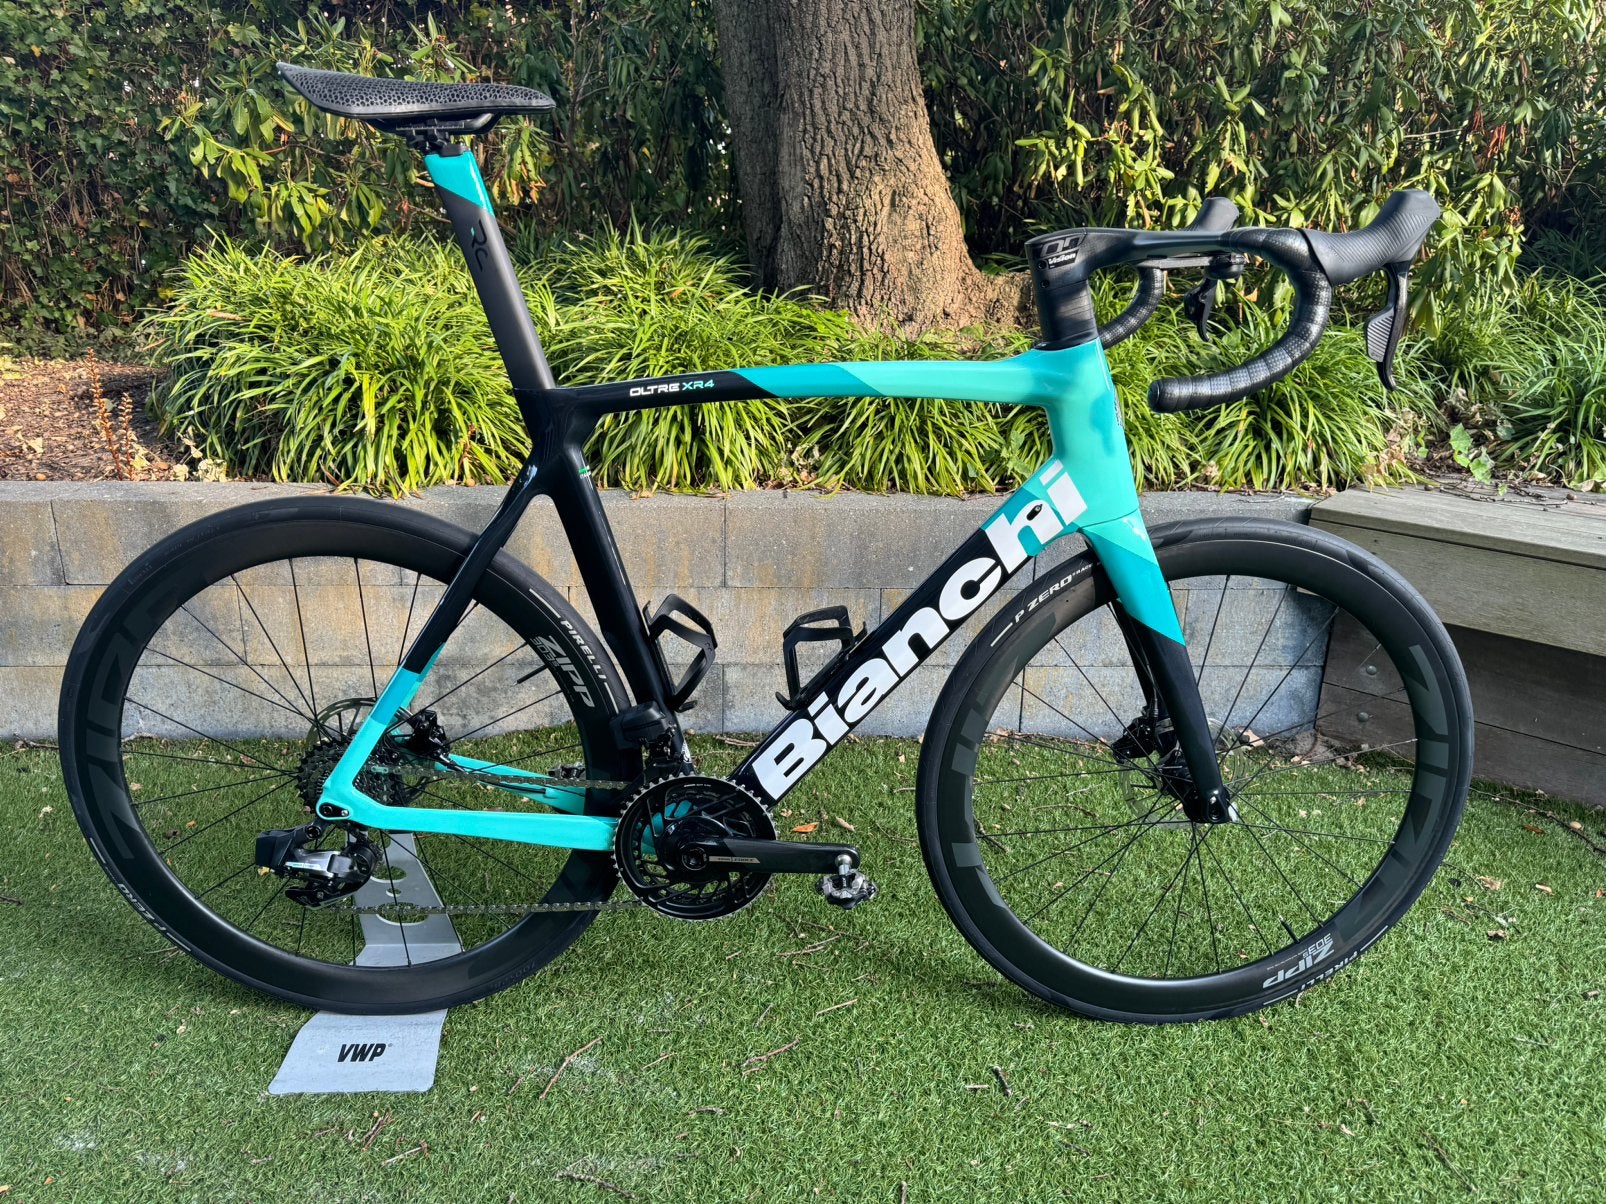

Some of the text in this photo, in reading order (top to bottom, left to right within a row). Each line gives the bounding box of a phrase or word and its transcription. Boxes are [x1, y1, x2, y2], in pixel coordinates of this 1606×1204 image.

[1048, 252, 1077, 265] Vision
[629, 379, 715, 397] OLTRE XR4
[1014, 609, 1025, 624] P
[1027, 574, 1073, 612] ZERO
[560, 620, 607, 680] PIRELLI
[752, 460, 1088, 801] Bianchi
[535, 634, 596, 708] ZIPP
[1262, 941, 1335, 989] ZIPP
[337, 1043, 387, 1063] VWP
